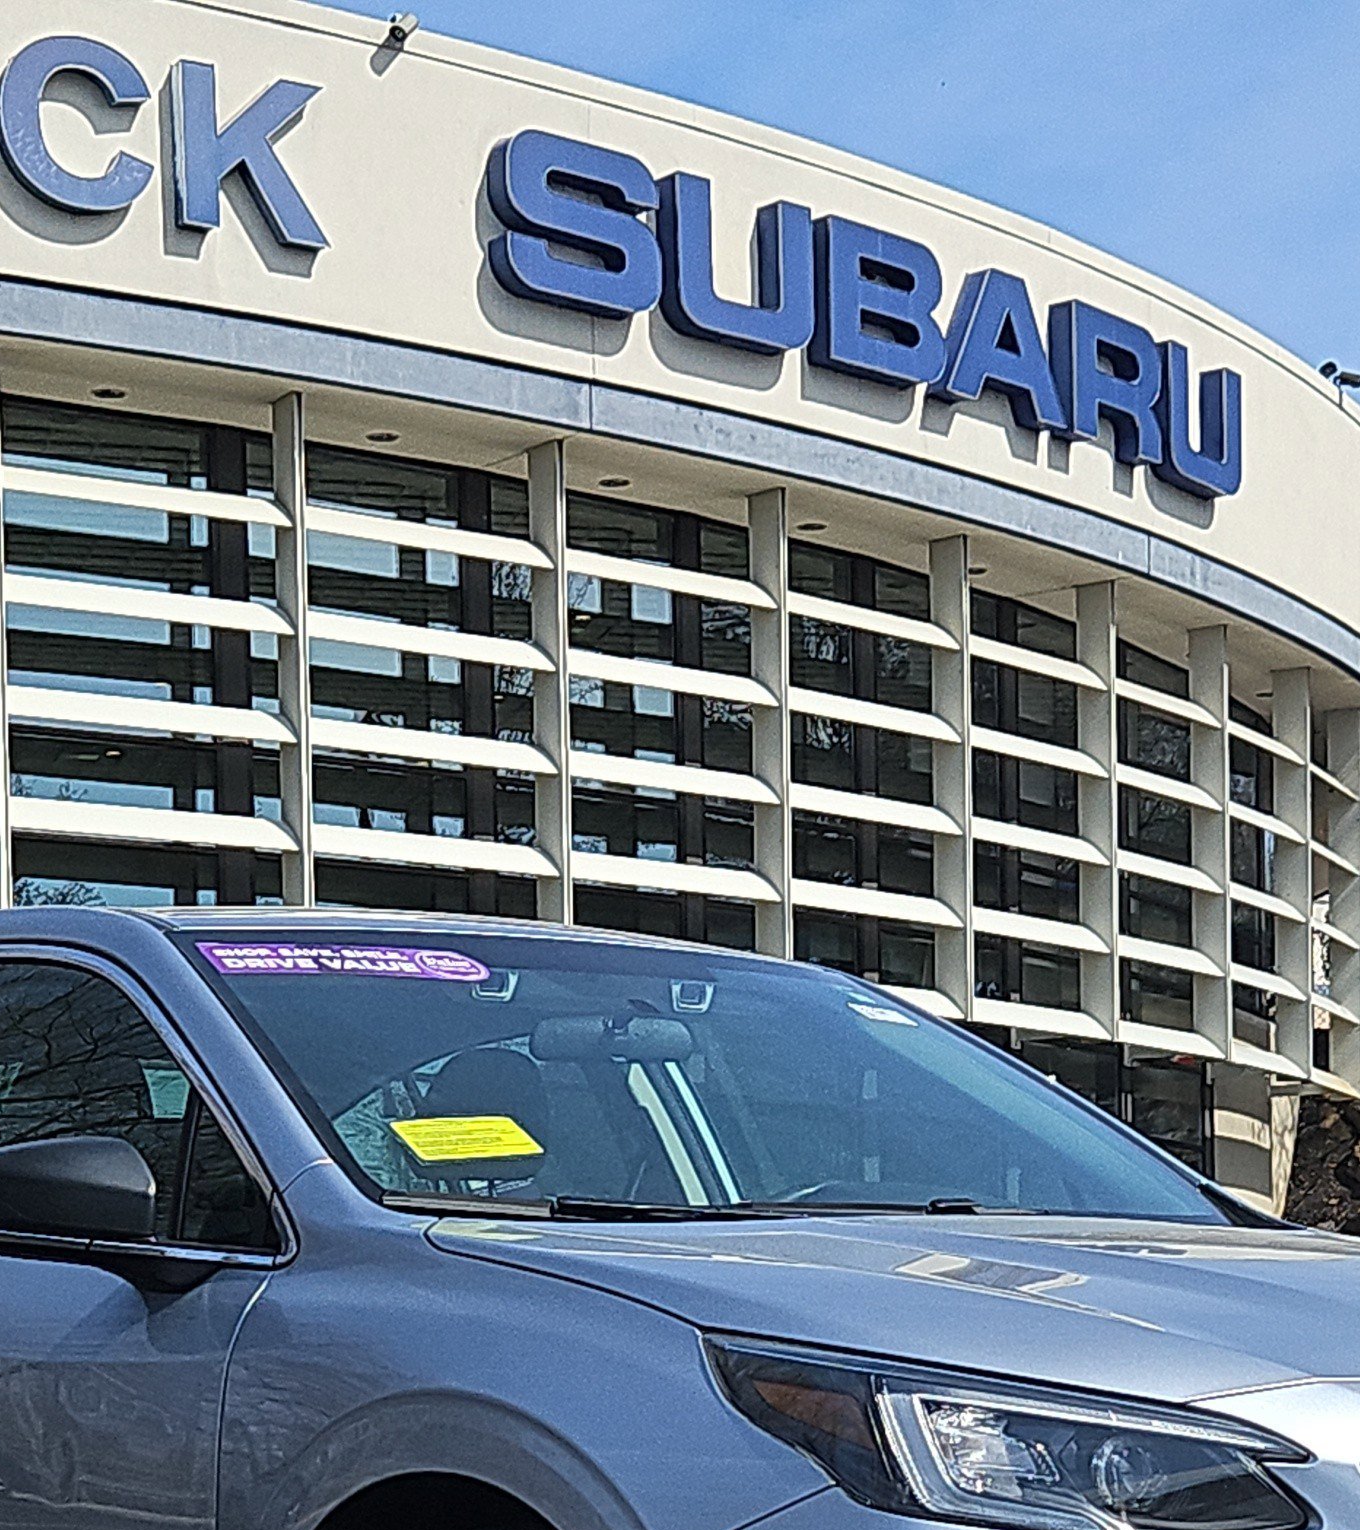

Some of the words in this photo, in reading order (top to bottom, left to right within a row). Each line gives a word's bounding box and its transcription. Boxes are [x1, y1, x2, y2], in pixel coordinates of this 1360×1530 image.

[485, 129, 1243, 500] SUBARU
[221, 958, 318, 969] DRIVE
[319, 958, 422, 973] VALUE
